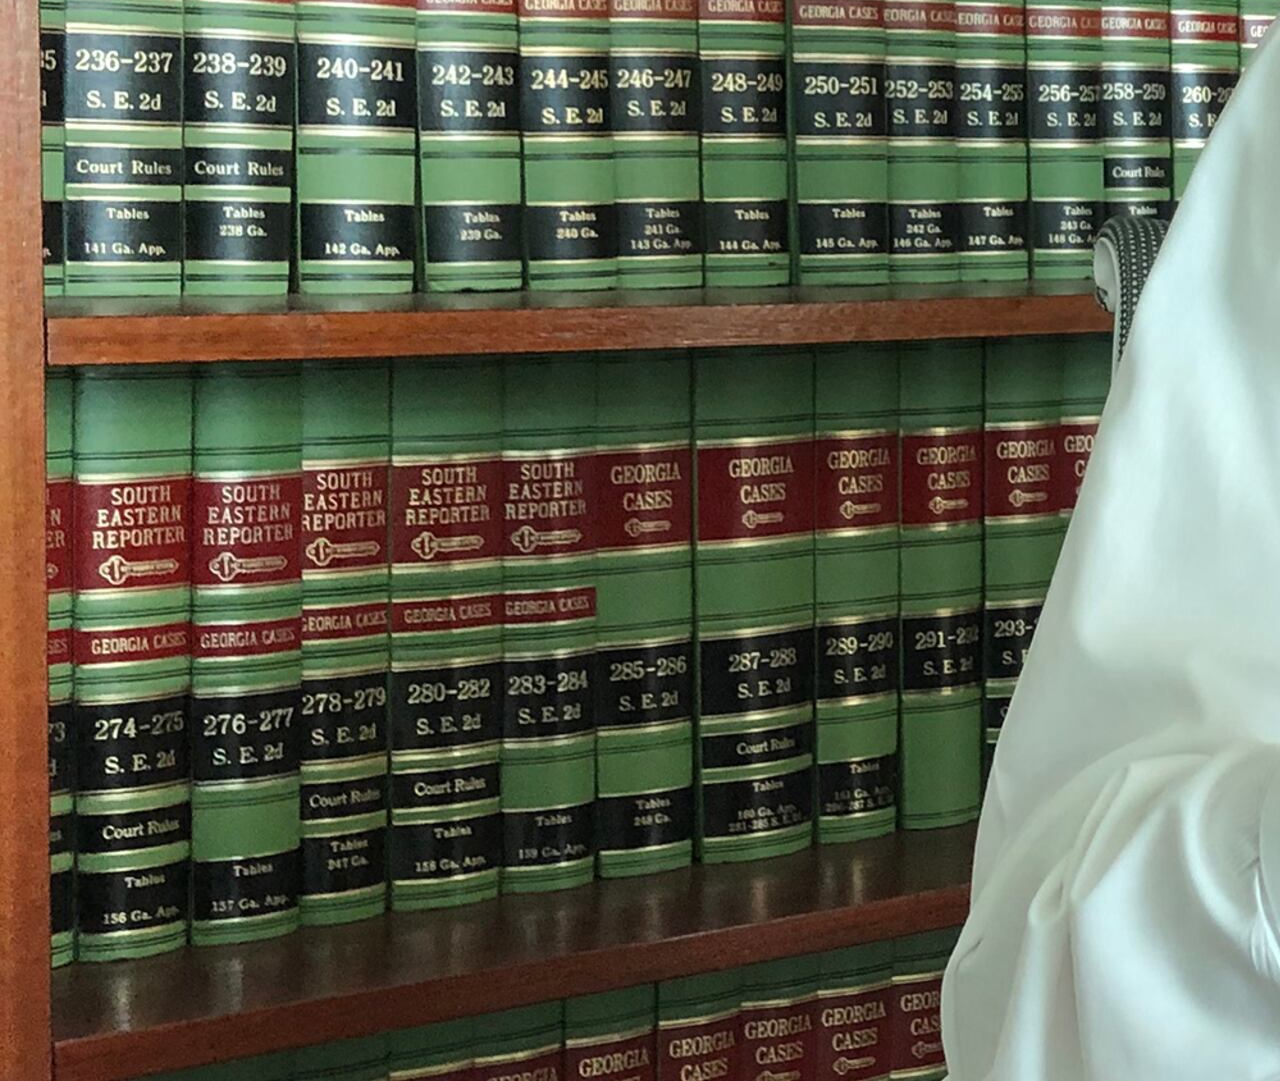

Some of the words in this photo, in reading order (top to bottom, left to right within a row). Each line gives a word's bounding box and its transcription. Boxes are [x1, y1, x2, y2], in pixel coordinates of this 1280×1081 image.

[75, 49, 173, 74] 236-237
[193, 52, 286, 77] 238-239
[317, 58, 404, 82] 240-241
[433, 64, 515, 87] 242-243
[531, 70, 608, 91] 244-245
[617, 69, 691, 90] 246-247
[712, 73, 783, 93] 248-249
[805, 77, 879, 95] 250-251
[87, 91, 106, 109] S.
[114, 91, 134, 110] E.
[139, 92, 161, 111] 2d
[885, 80, 954, 100] 252-253
[1103, 83, 1165, 101] 258-259
[76, 160, 124, 175] Court
[132, 161, 172, 177] Rules
[194, 160, 239, 175] Court
[247, 161, 284, 177] Rules
[106, 207, 149, 220] Tables
[111, 243, 134, 256] Ga.
[827, 449, 891, 471] GEORGIA
[996, 441, 1055, 460] GEORGIA
[422, 467, 477, 486] SOUTH
[611, 463, 681, 485] GEORGIA
[729, 456, 793, 479] GEORGIA
[1007, 465, 1050, 485] CASES
[111, 485, 171, 504] SOUTH
[222, 484, 280, 503] SOUTH
[409, 485, 486, 504] EASTERN
[740, 483, 786, 505] CASES
[838, 475, 883, 495] CASES
[623, 490, 673, 511] CASES
[97, 505, 182, 527] EASTERN
[208, 503, 290, 524] EASTERN
[405, 504, 490, 526] REPORTER
[92, 526, 185, 549] REPORTER
[203, 523, 293, 546] REPORTER
[91, 636, 148, 655] GEORGIA
[154, 632, 186, 649] CASES
[826, 631, 893, 655] 289-290
[610, 656, 687, 682] 285-286
[728, 648, 796, 673] 287-288
[408, 679, 490, 704] 280-282
[508, 672, 588, 697] 283-284
[302, 687, 386, 714] 278-279
[95, 711, 184, 740] 274-275
[204, 707, 293, 736] 276-277
[821, 1001, 886, 1028] GEORGIA
[745, 1014, 812, 1040] GEORGIA
[832, 1027, 878, 1051] CASES
